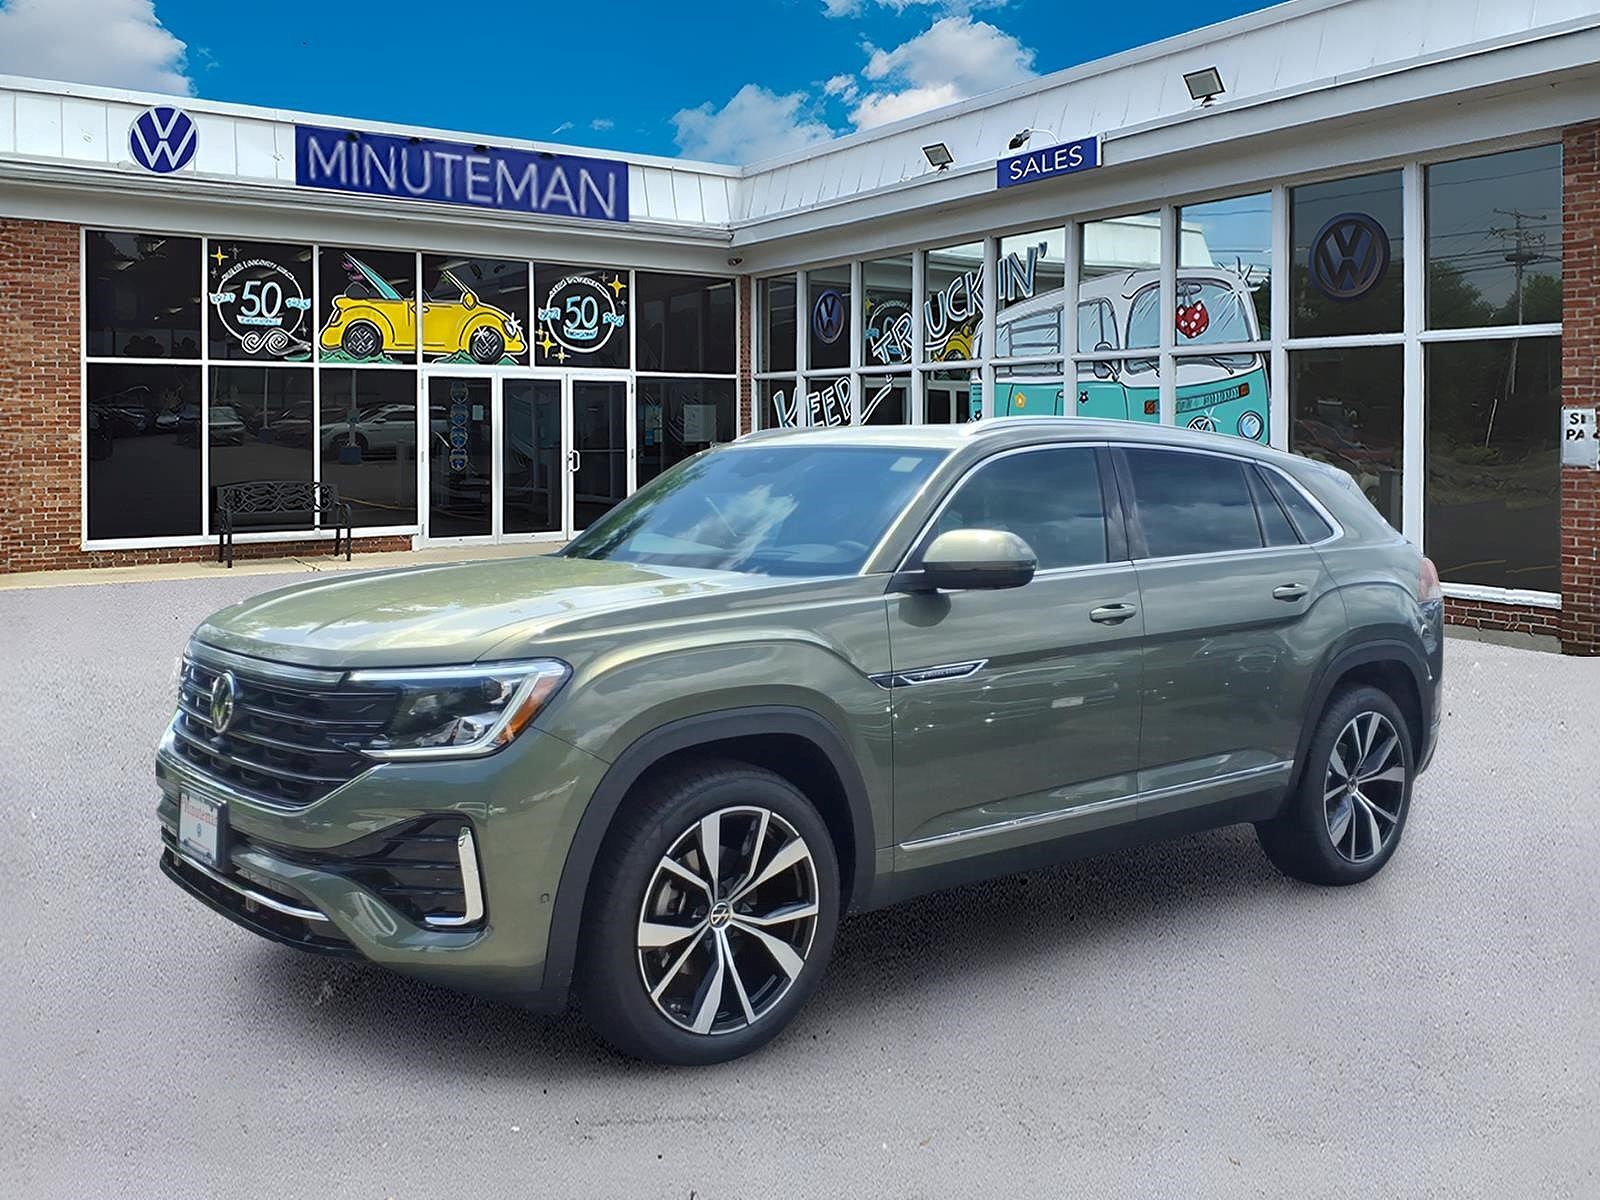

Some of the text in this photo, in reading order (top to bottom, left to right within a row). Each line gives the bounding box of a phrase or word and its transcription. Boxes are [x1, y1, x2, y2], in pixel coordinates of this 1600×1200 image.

[129, 104, 199, 173] VW
[307, 136, 617, 219] MINUTEMAN
[1009, 144, 1085, 181] SALES
[240, 280, 282, 318] 50
[565, 296, 598, 329] 50
[773, 376, 852, 428] KEEP
